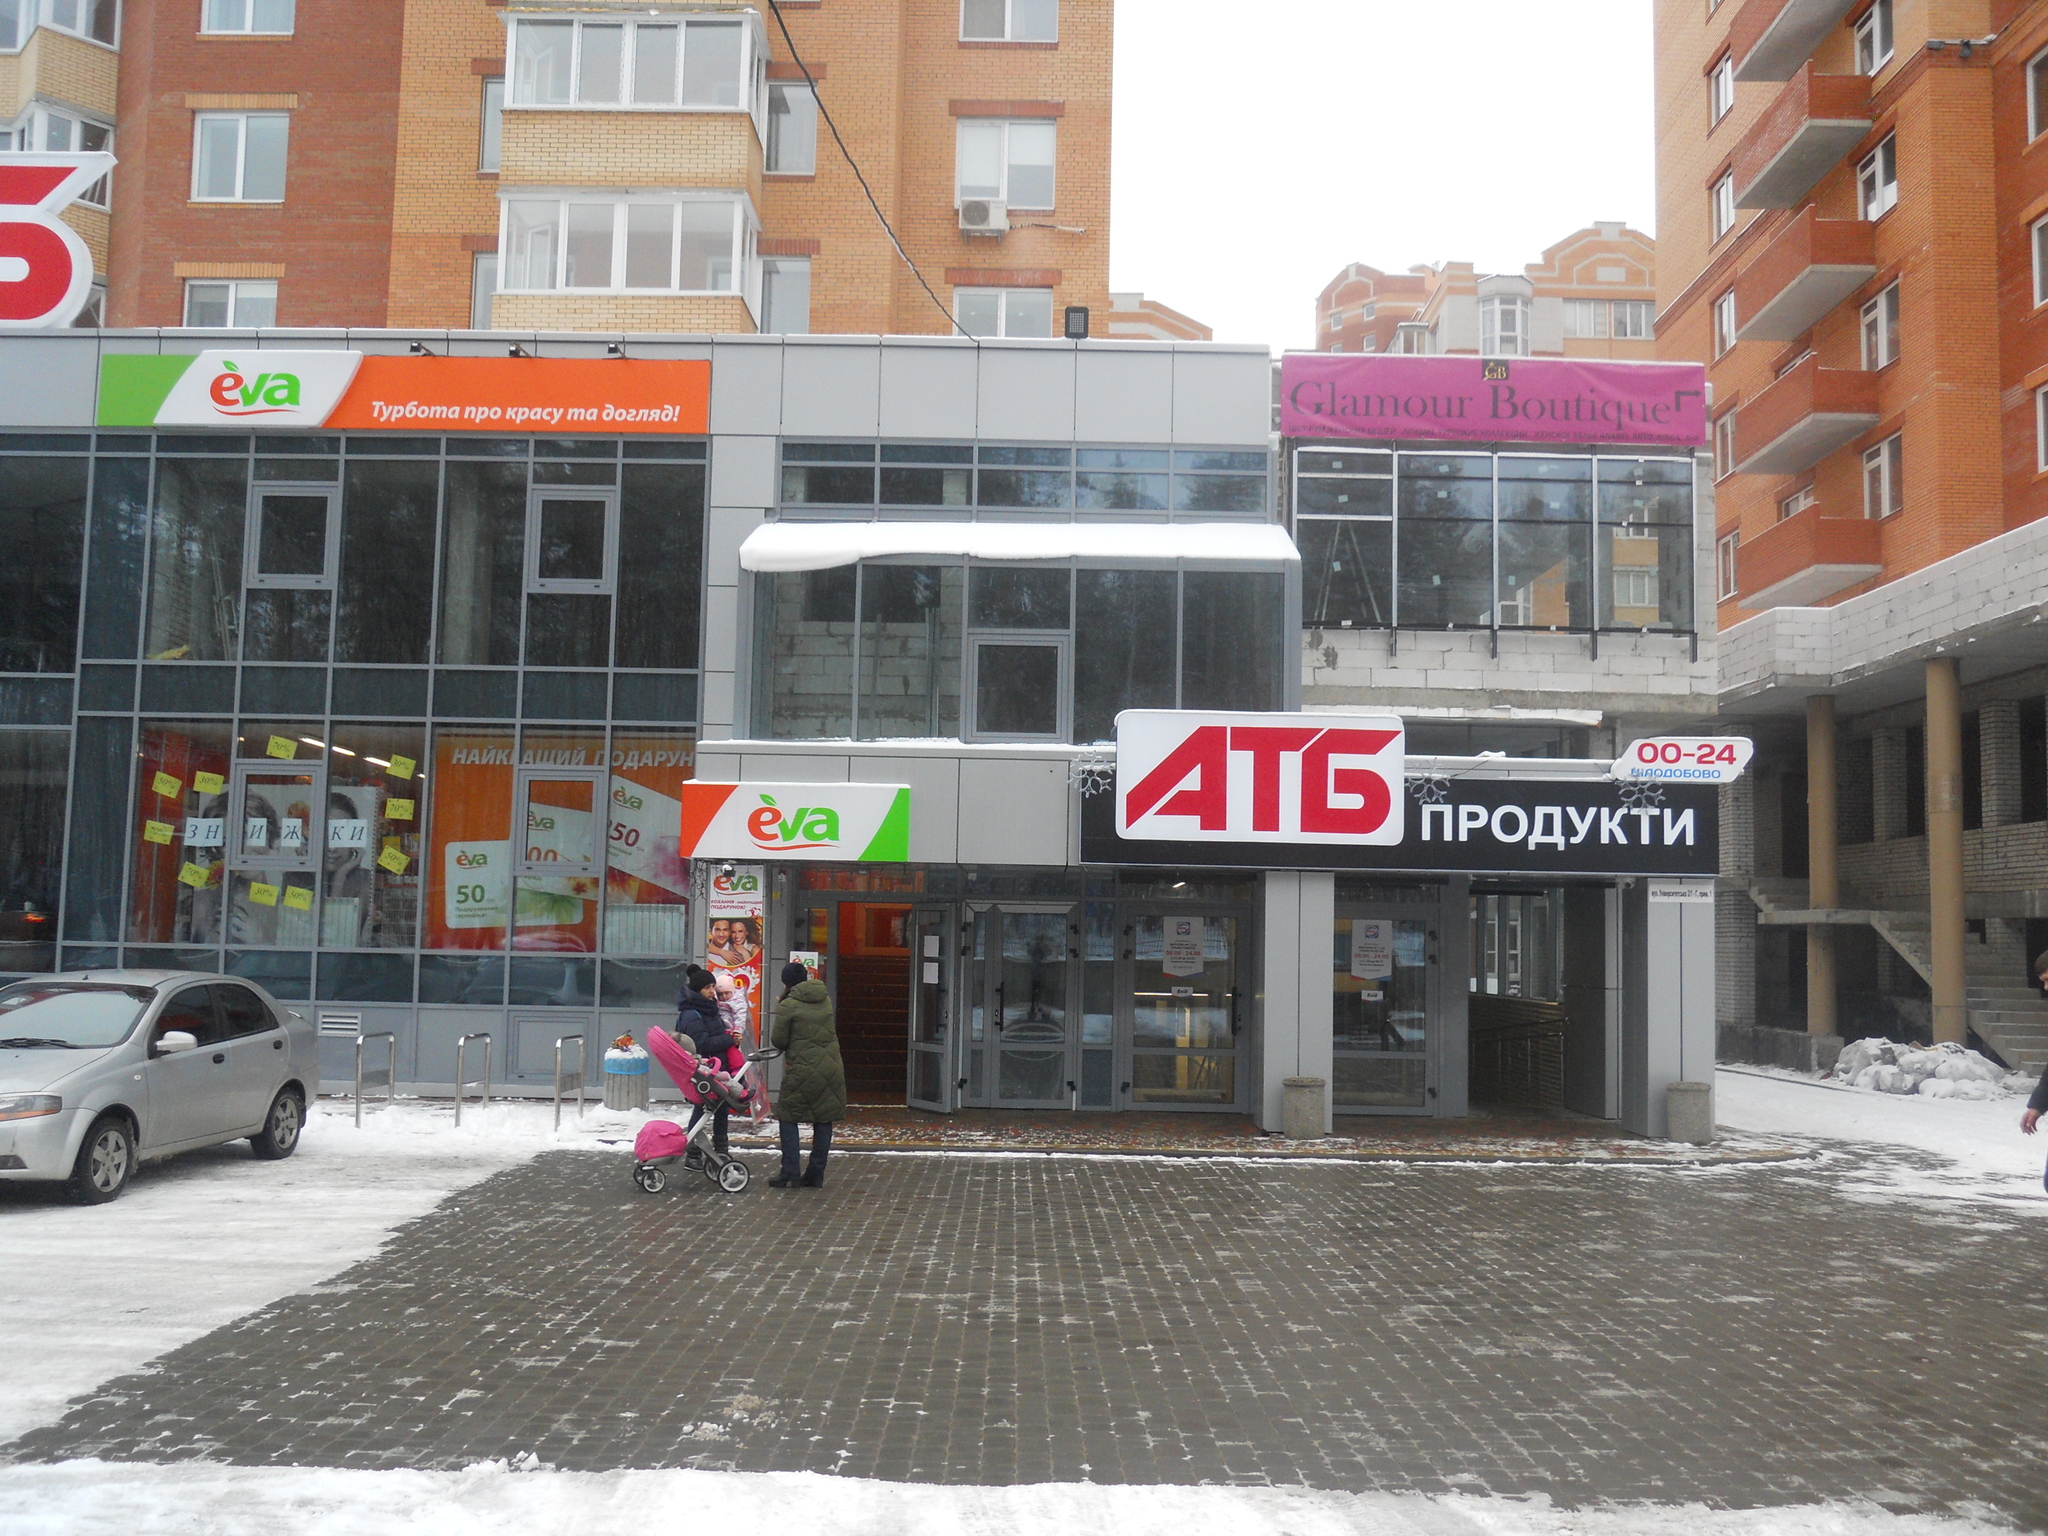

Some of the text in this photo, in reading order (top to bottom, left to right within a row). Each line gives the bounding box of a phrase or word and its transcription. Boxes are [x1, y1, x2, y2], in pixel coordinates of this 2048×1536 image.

[372, 401, 681, 424] Турбота про красу та догляд!
[1290, 380, 1672, 431] Glamour Boutique
[1637, 742, 1737, 765] 00-24
[1125, 725, 1403, 835] АТБ
[1421, 804, 1695, 851] ПРОДУКТИ
[456, 884, 486, 904] 50
